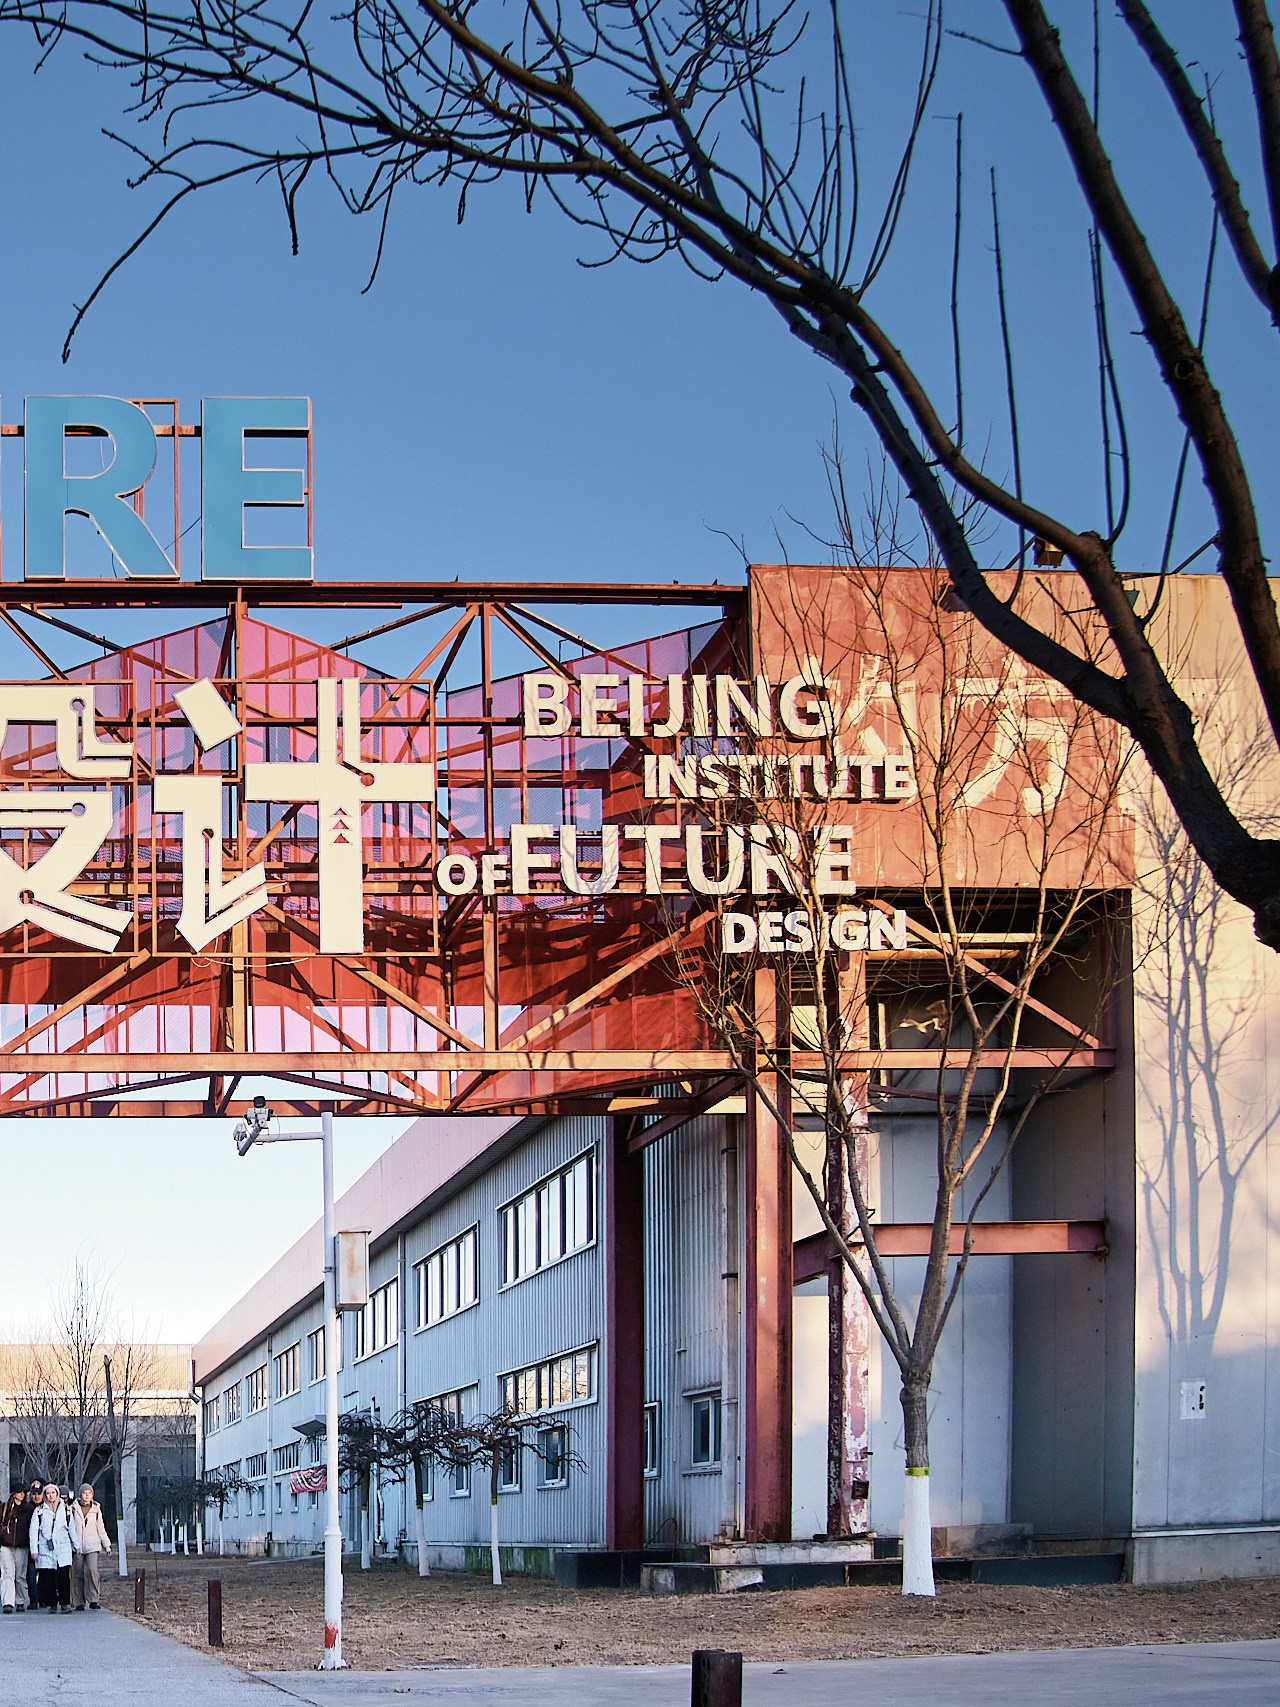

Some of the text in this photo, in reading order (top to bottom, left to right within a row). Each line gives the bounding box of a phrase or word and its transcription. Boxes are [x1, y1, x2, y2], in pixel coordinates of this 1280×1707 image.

[522, 672, 832, 739] BEIJING
[644, 754, 912, 800] INSTITUTE
[436, 824, 858, 896] OF FUTURE
[723, 909, 909, 955] DESIGN
